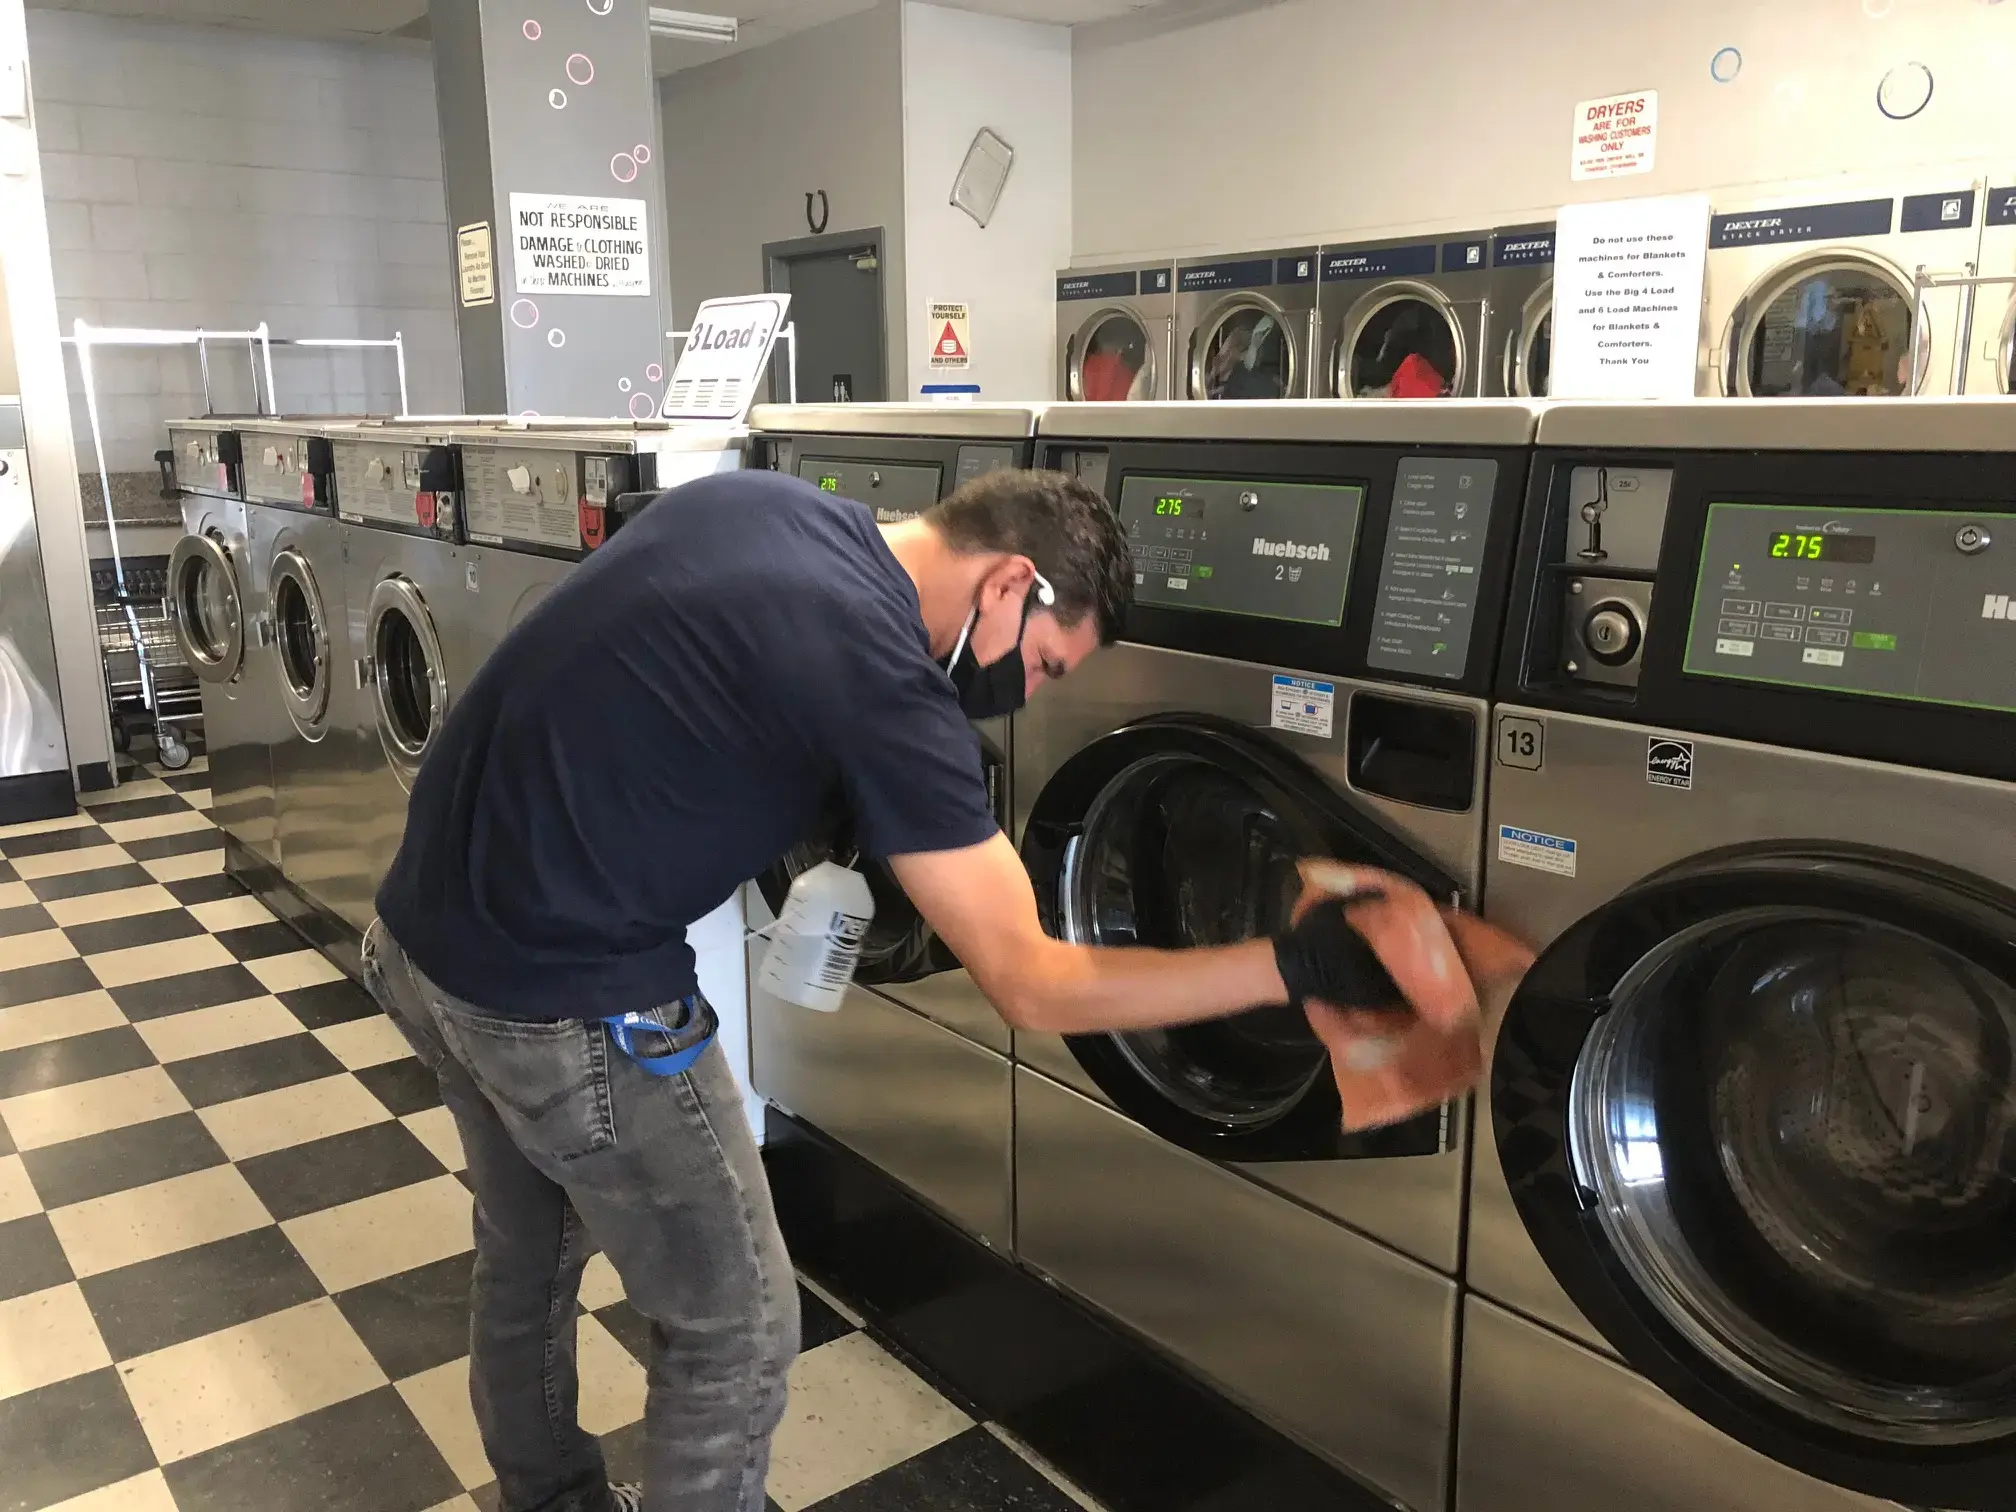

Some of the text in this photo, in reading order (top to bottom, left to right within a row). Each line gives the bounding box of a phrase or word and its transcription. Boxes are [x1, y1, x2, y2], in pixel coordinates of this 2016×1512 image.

[1587, 98, 1645, 120] DRYERS
[1593, 117, 1636, 131] ARE FOR
[1579, 125, 1651, 144] WASHING CUSTOMERS
[1601, 141, 1624, 152] ONLY
[519, 211, 638, 231] NOT RESPONSIBLE
[1723, 217, 1781, 231] DEXTER
[1646, 234, 1674, 242] these
[1722, 231, 1761, 241] STACK
[520, 236, 574, 253] DAMAGE
[584, 238, 643, 255] CLOTHING
[1504, 240, 1549, 251] DEXTER
[1503, 251, 1533, 260] STACK
[1578, 254, 1624, 263] machines
[1643, 251, 1686, 260] Blankets
[533, 254, 630, 271] WASHED DRIED
[1329, 257, 1367, 267] DEXTER
[548, 272, 610, 287] MACHINES
[1185, 271, 1216, 280] DEXTER
[1597, 270, 1664, 279] & Comforters.
[1063, 281, 1089, 289] DEXTER
[1584, 289, 1603, 297] Use
[1606, 288, 1621, 296] the
[1624, 288, 1639, 297] Big
[1650, 286, 1675, 295] Load
[933, 304, 963, 312] PROTECT
[1578, 306, 1596, 314] and
[1633, 304, 1678, 313] Machines
[931, 312, 966, 320] YOURSELF
[1608, 322, 1650, 331] Blankets
[1597, 340, 1653, 348] Comforters.
[1631, 357, 1649, 365] You
[1156, 498, 1182, 516] 2.75
[1252, 538, 1330, 561] Huebsch
[1772, 534, 1823, 559] 2.75
[1275, 564, 1284, 581] 2
[1291, 679, 1316, 689] NOTICE
[1507, 730, 1535, 756] 13
[1648, 773, 1690, 787] ENERGY STAR
[1511, 830, 1565, 849] NOTICE
